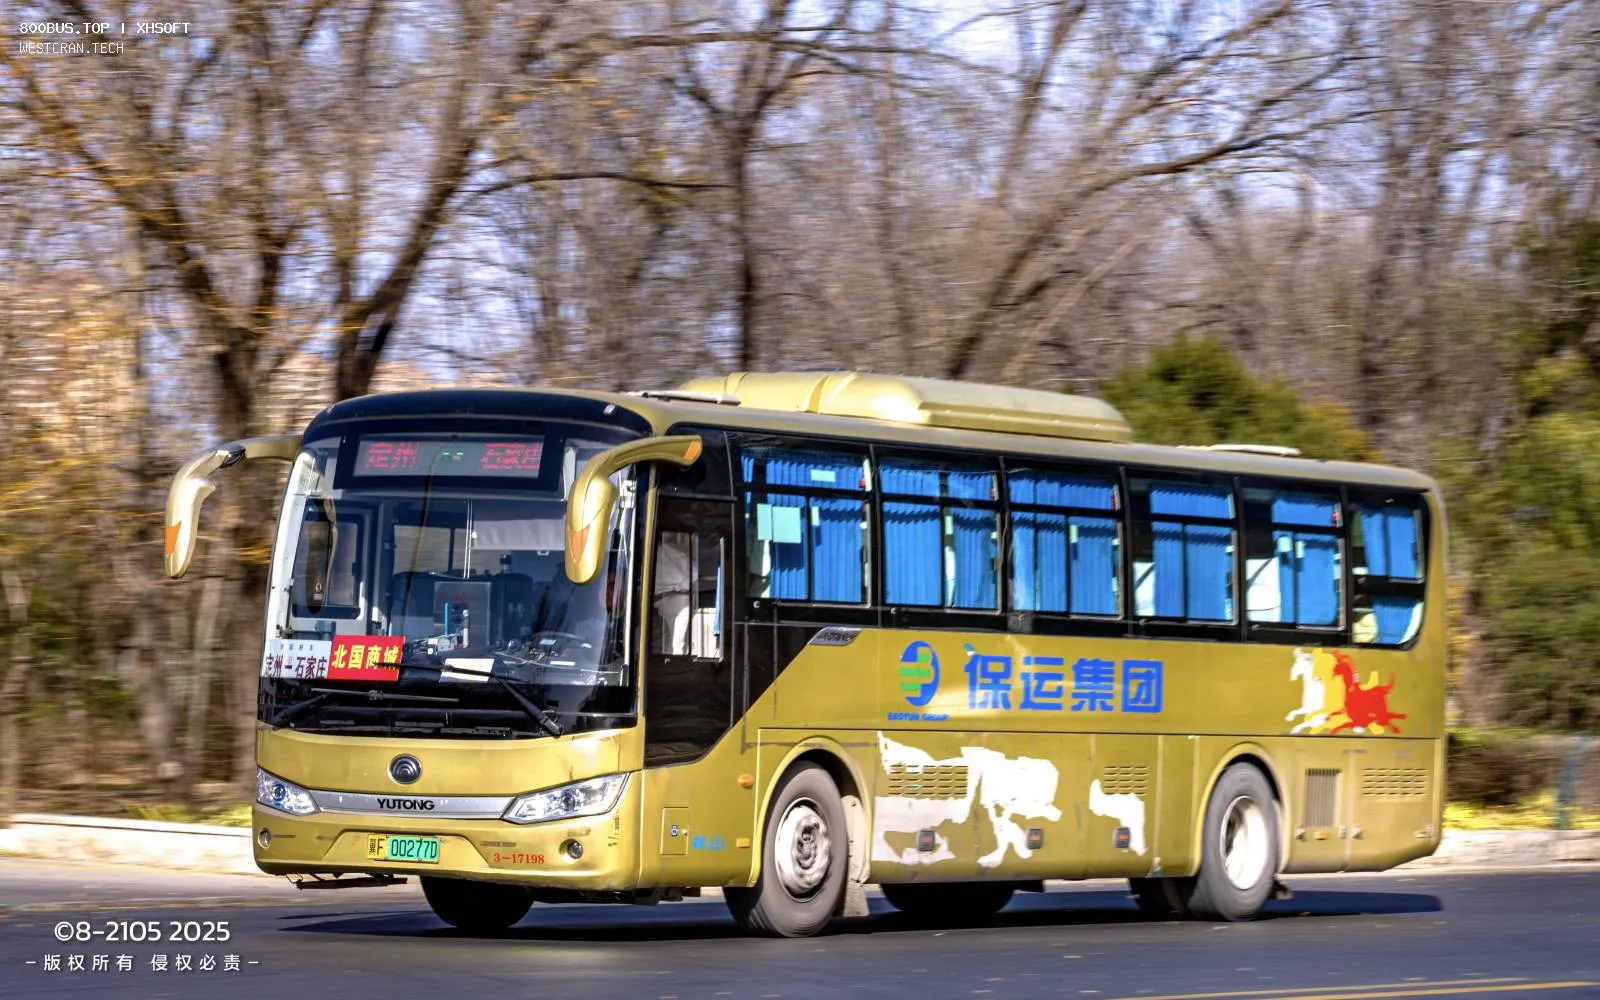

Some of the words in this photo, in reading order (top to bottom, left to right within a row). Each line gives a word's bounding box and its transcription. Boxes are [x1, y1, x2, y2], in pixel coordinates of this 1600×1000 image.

[331, 644, 399, 670] 北国商城
[964, 642, 1164, 713] 保运集团
[377, 798, 435, 811] YUTONG
